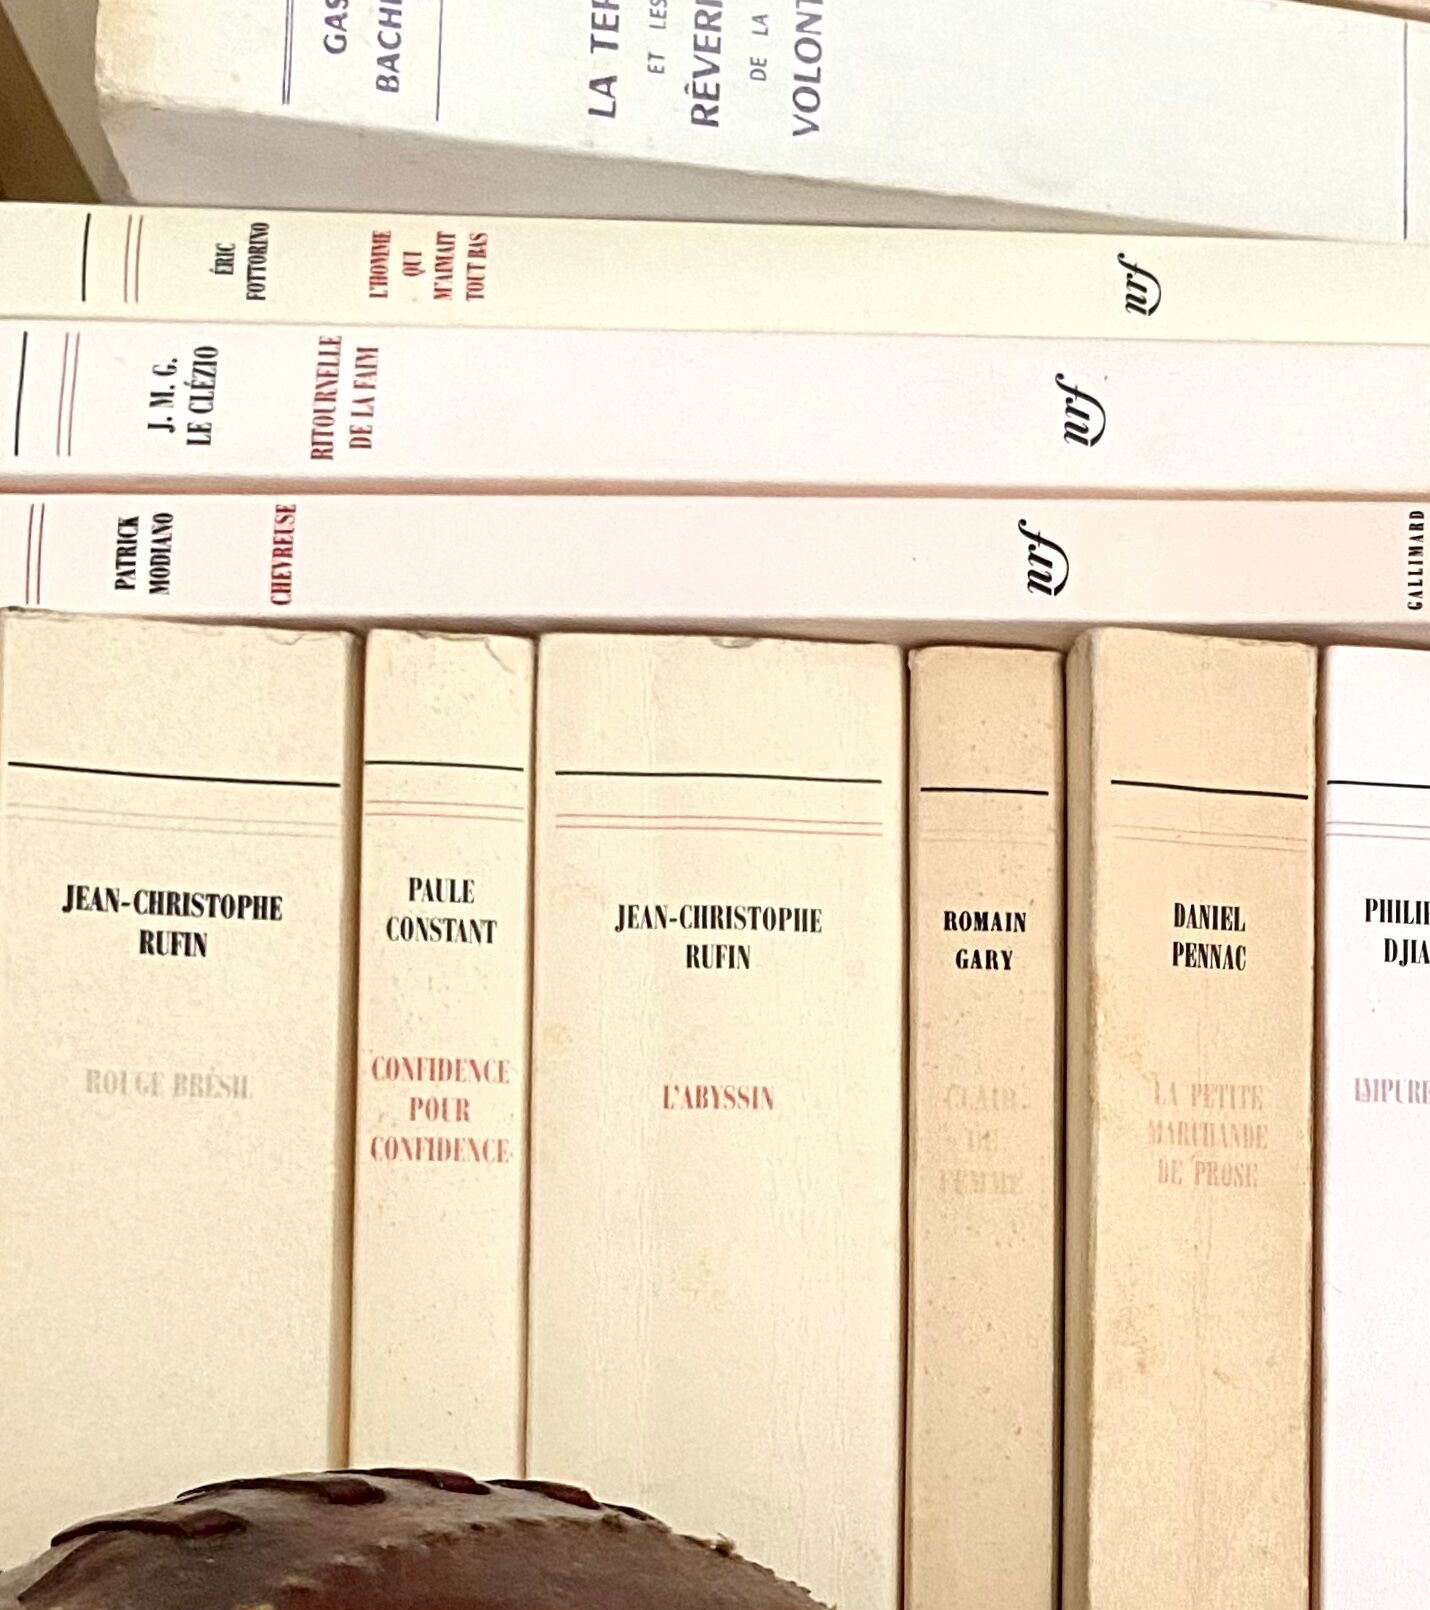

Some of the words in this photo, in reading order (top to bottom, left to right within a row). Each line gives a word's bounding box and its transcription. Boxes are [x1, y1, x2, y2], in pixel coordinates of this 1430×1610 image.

[322, 0, 349, 54] GAS
[650, 0, 667, 31] LES
[751, 13, 769, 37] LA
[647, 51, 665, 74] ET
[750, 57, 768, 82] DE
[793, 0, 823, 137] VOLONT
[587, 74, 618, 119] LA
[208, 241, 236, 277] ÉRIC
[466, 231, 489, 259] BAS
[245, 221, 271, 302] FOTTORINO
[368, 229, 391, 300] L'HOMME
[402, 250, 424, 278] QUI
[432, 229, 458, 302] M'AIMAIT
[466, 263, 488, 302] TOUT
[1116, 251, 1163, 318] nrf
[152, 355, 179, 378] G.
[183, 345, 220, 417] CLÉZIO
[353, 345, 380, 391] FAIM
[149, 380, 177, 408] M.
[309, 334, 343, 462] RITOURNELLE
[350, 396, 375, 423] LA
[146, 413, 174, 434] J.
[1054, 372, 1108, 449] nrf
[186, 420, 213, 448] LE
[349, 425, 373, 451] DE
[114, 516, 140, 592] PATRICK
[148, 511, 174, 596] MODIANO
[271, 503, 298, 607] CHEVREUSE
[1017, 518, 1070, 598] nrf
[1407, 509, 1426, 612] GALLIMARD
[60, 883, 284, 923] JEAN-CHRISTOPHE
[406, 876, 477, 906] PAULE
[385, 914, 499, 946] CONSTANT
[613, 902, 823, 935] JEAN-CHRISTOPHE
[942, 909, 1028, 934] ROMAIN
[1172, 901, 1248, 934] DANIEL
[137, 930, 209, 959] RUFIN
[684, 943, 752, 972] RUFIN
[954, 947, 1015, 972] GARY
[1170, 940, 1248, 972] PENNAC
[370, 1056, 511, 1085] CONFIDENCE
[408, 1096, 471, 1124] POUR
[662, 1082, 776, 1112] L'ABYSSIN
[1153, 1080, 1178, 1107] LA
[1190, 1083, 1264, 1111] PETITE
[368, 1136, 513, 1164] CONFIDENCE
[1148, 1119, 1269, 1150] MARCHANDE
[1158, 1158, 1183, 1185] DE
[1193, 1160, 1258, 1188] PROSE
